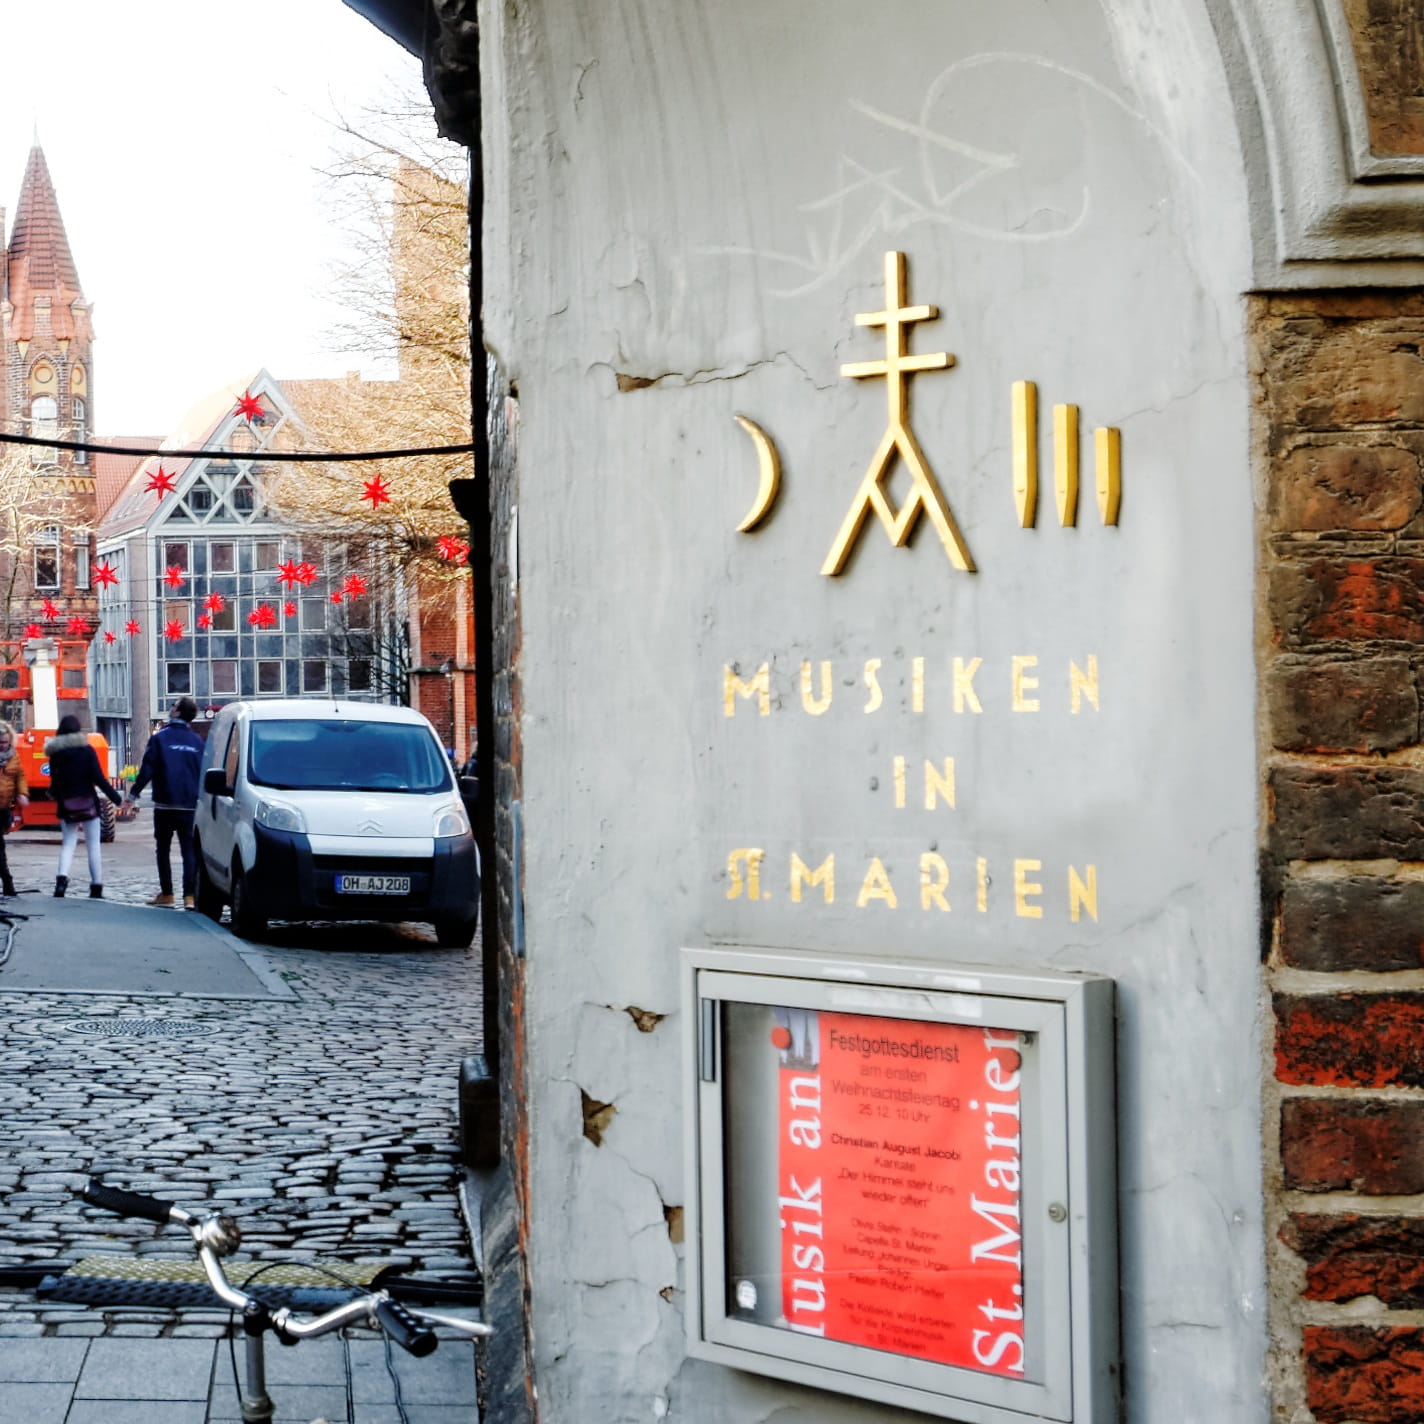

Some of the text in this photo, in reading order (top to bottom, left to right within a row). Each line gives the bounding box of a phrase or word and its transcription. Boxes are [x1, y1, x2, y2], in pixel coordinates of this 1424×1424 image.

[723, 654, 1100, 717] MUSIKEN
[893, 755, 956, 810] IN
[343, 877, 360, 889] OH
[789, 851, 1099, 923] MARIEN
[829, 1029, 960, 1064] Festgottesdienst
[831, 1133, 879, 1150] Christian
[882, 1140, 921, 1156] August
[778, 1074, 826, 1337] usik an
[972, 1281, 1025, 1373] St.
